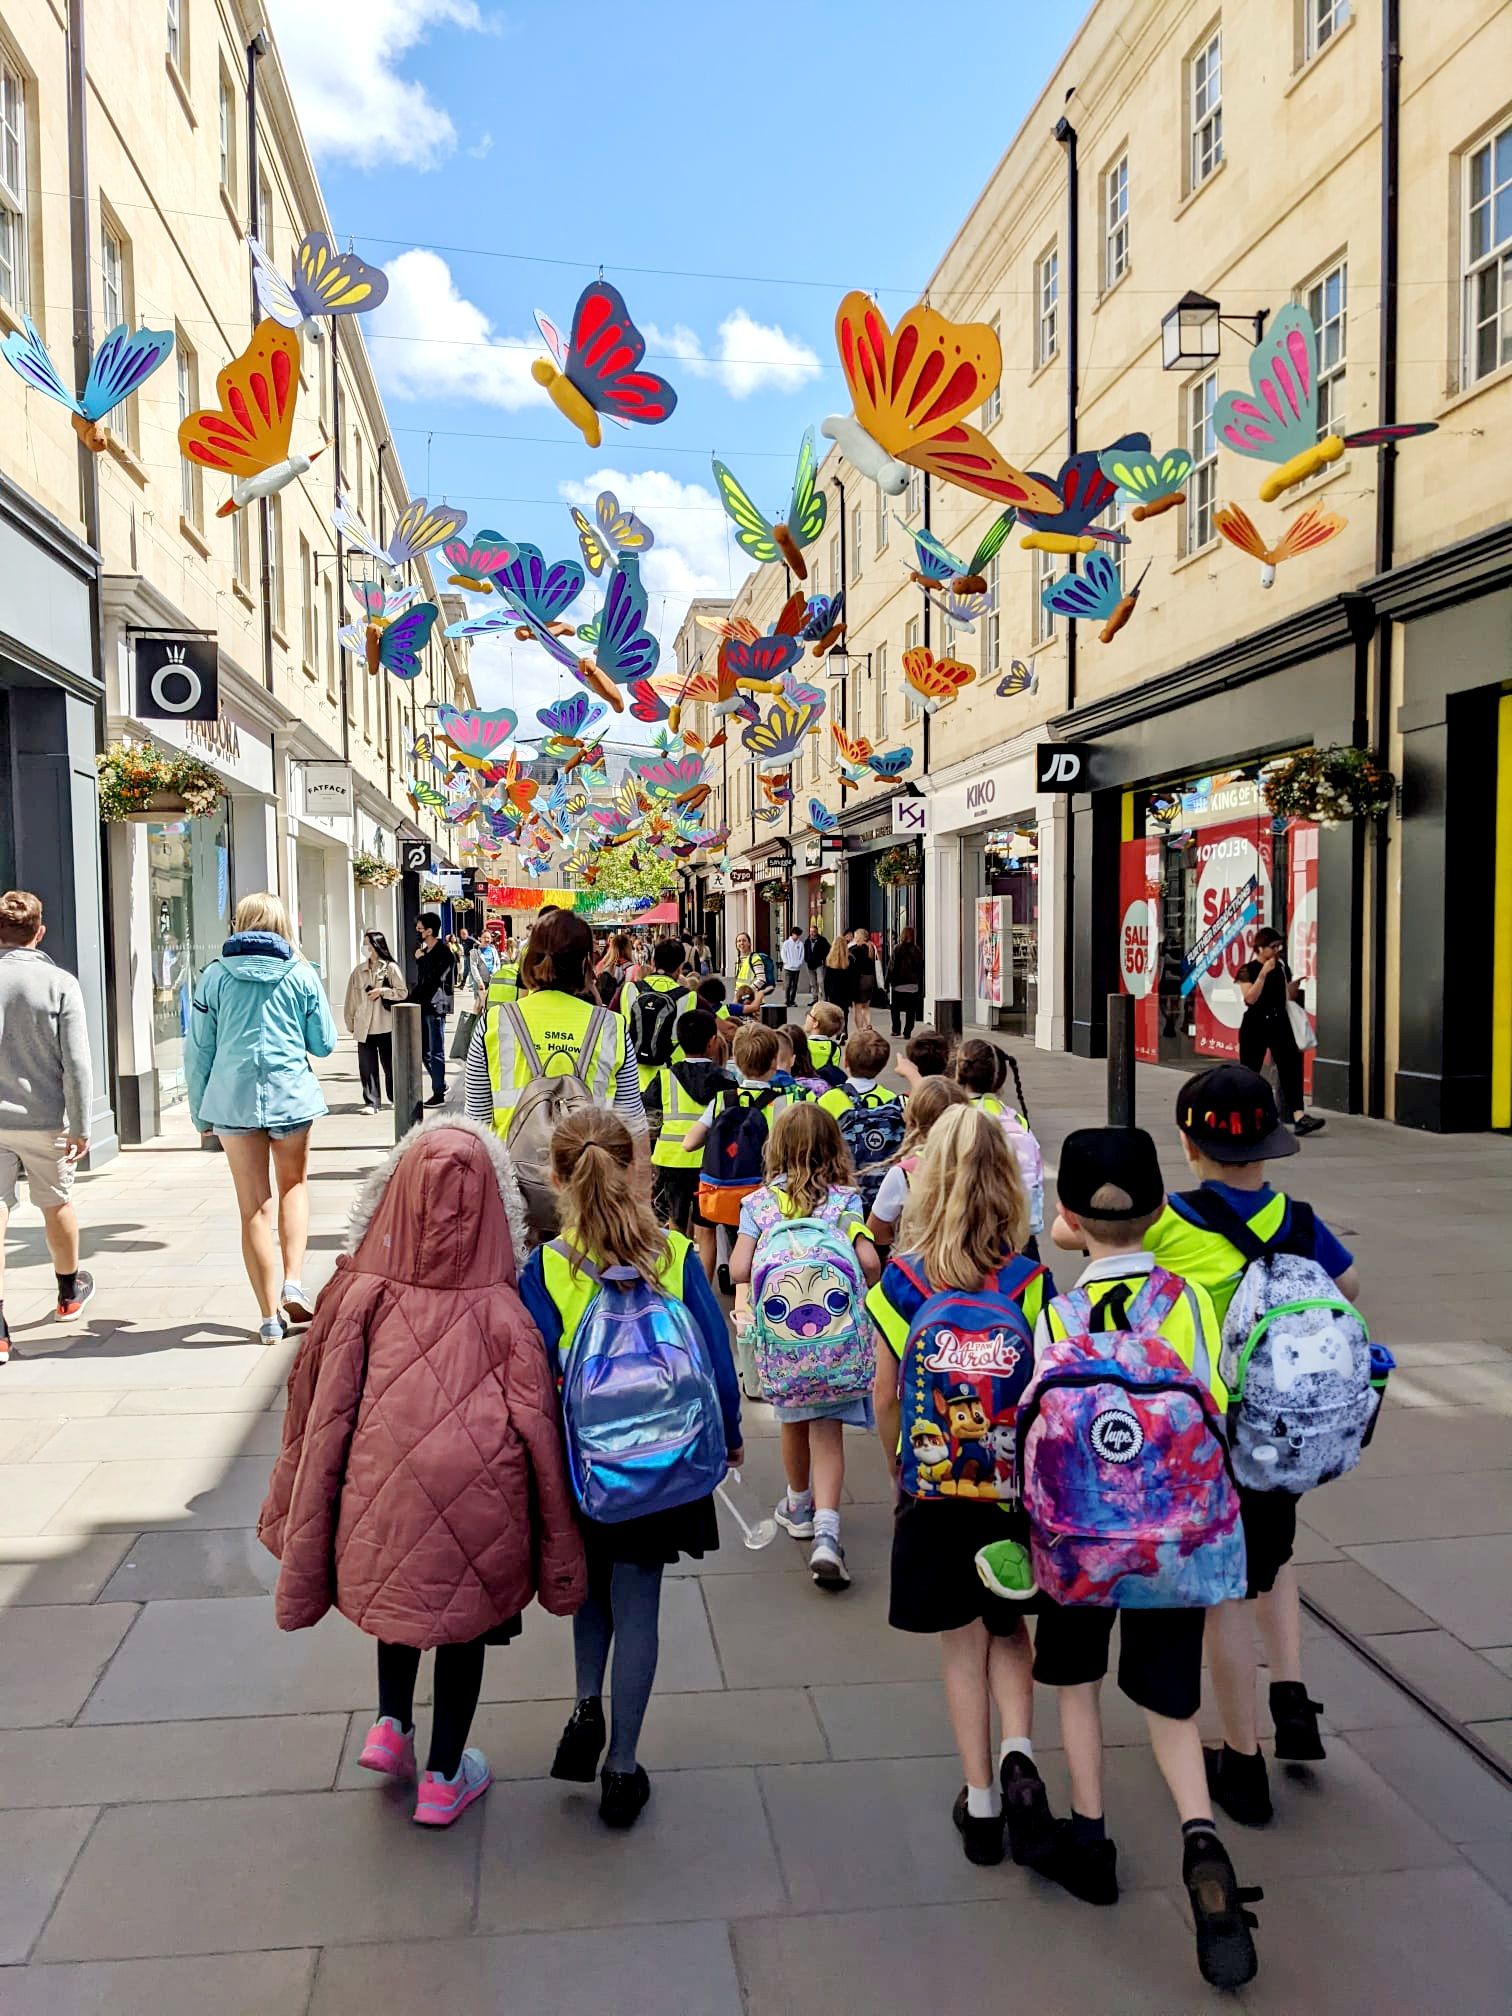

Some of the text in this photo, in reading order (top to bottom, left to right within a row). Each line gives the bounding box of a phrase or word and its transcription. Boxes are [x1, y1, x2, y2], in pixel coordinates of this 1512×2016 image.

[1041, 753, 1081, 783] JD
[307, 784, 347, 795] FATFACE
[966, 778, 996, 810] KIKO
[1211, 790, 1238, 811] KING
[1239, 788, 1250, 800] OF
[544, 1031, 574, 1041] SMSA
[925, 1331, 1006, 1371] Patrol
[975, 1342, 993, 1352] PAW
[1103, 1421, 1133, 1450] hype
